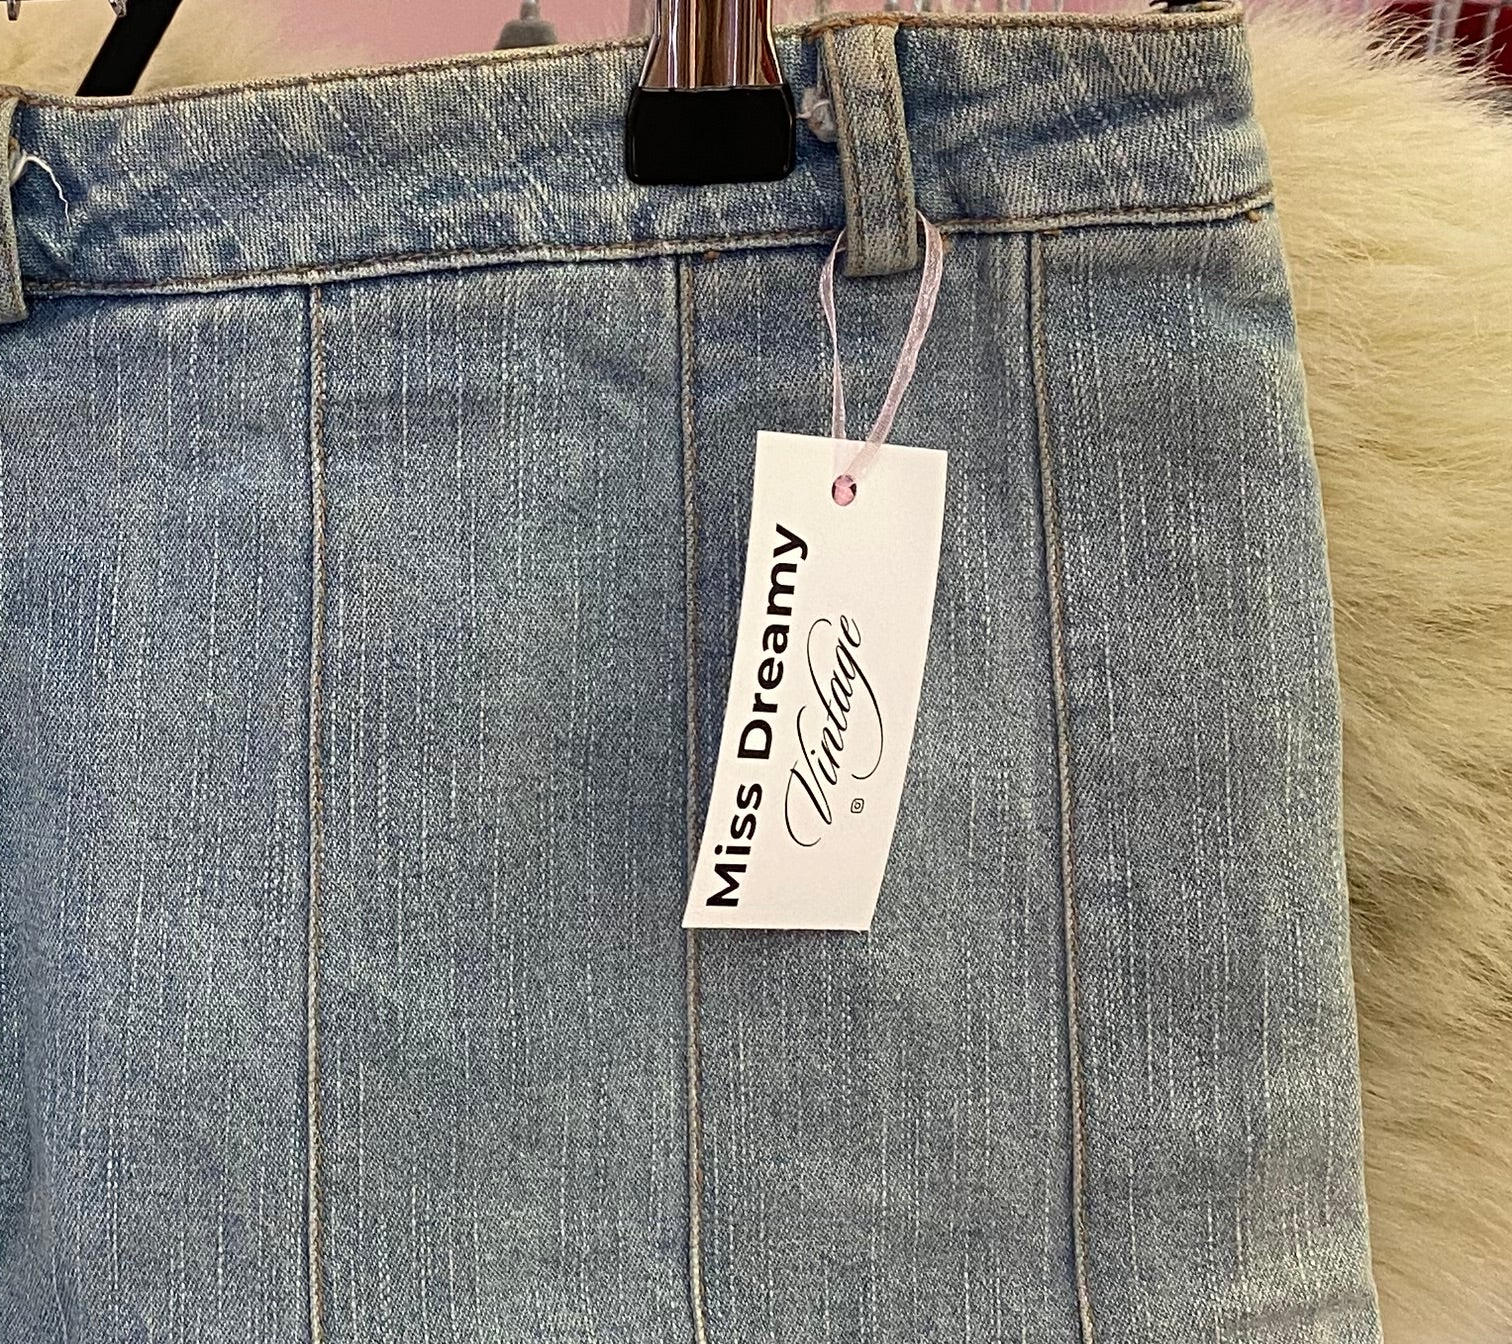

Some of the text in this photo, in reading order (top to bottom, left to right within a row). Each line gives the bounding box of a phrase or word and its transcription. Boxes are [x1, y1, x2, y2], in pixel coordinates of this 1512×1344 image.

[705, 523, 808, 908] Miss Dreamy
[784, 613, 884, 848] Vintage
